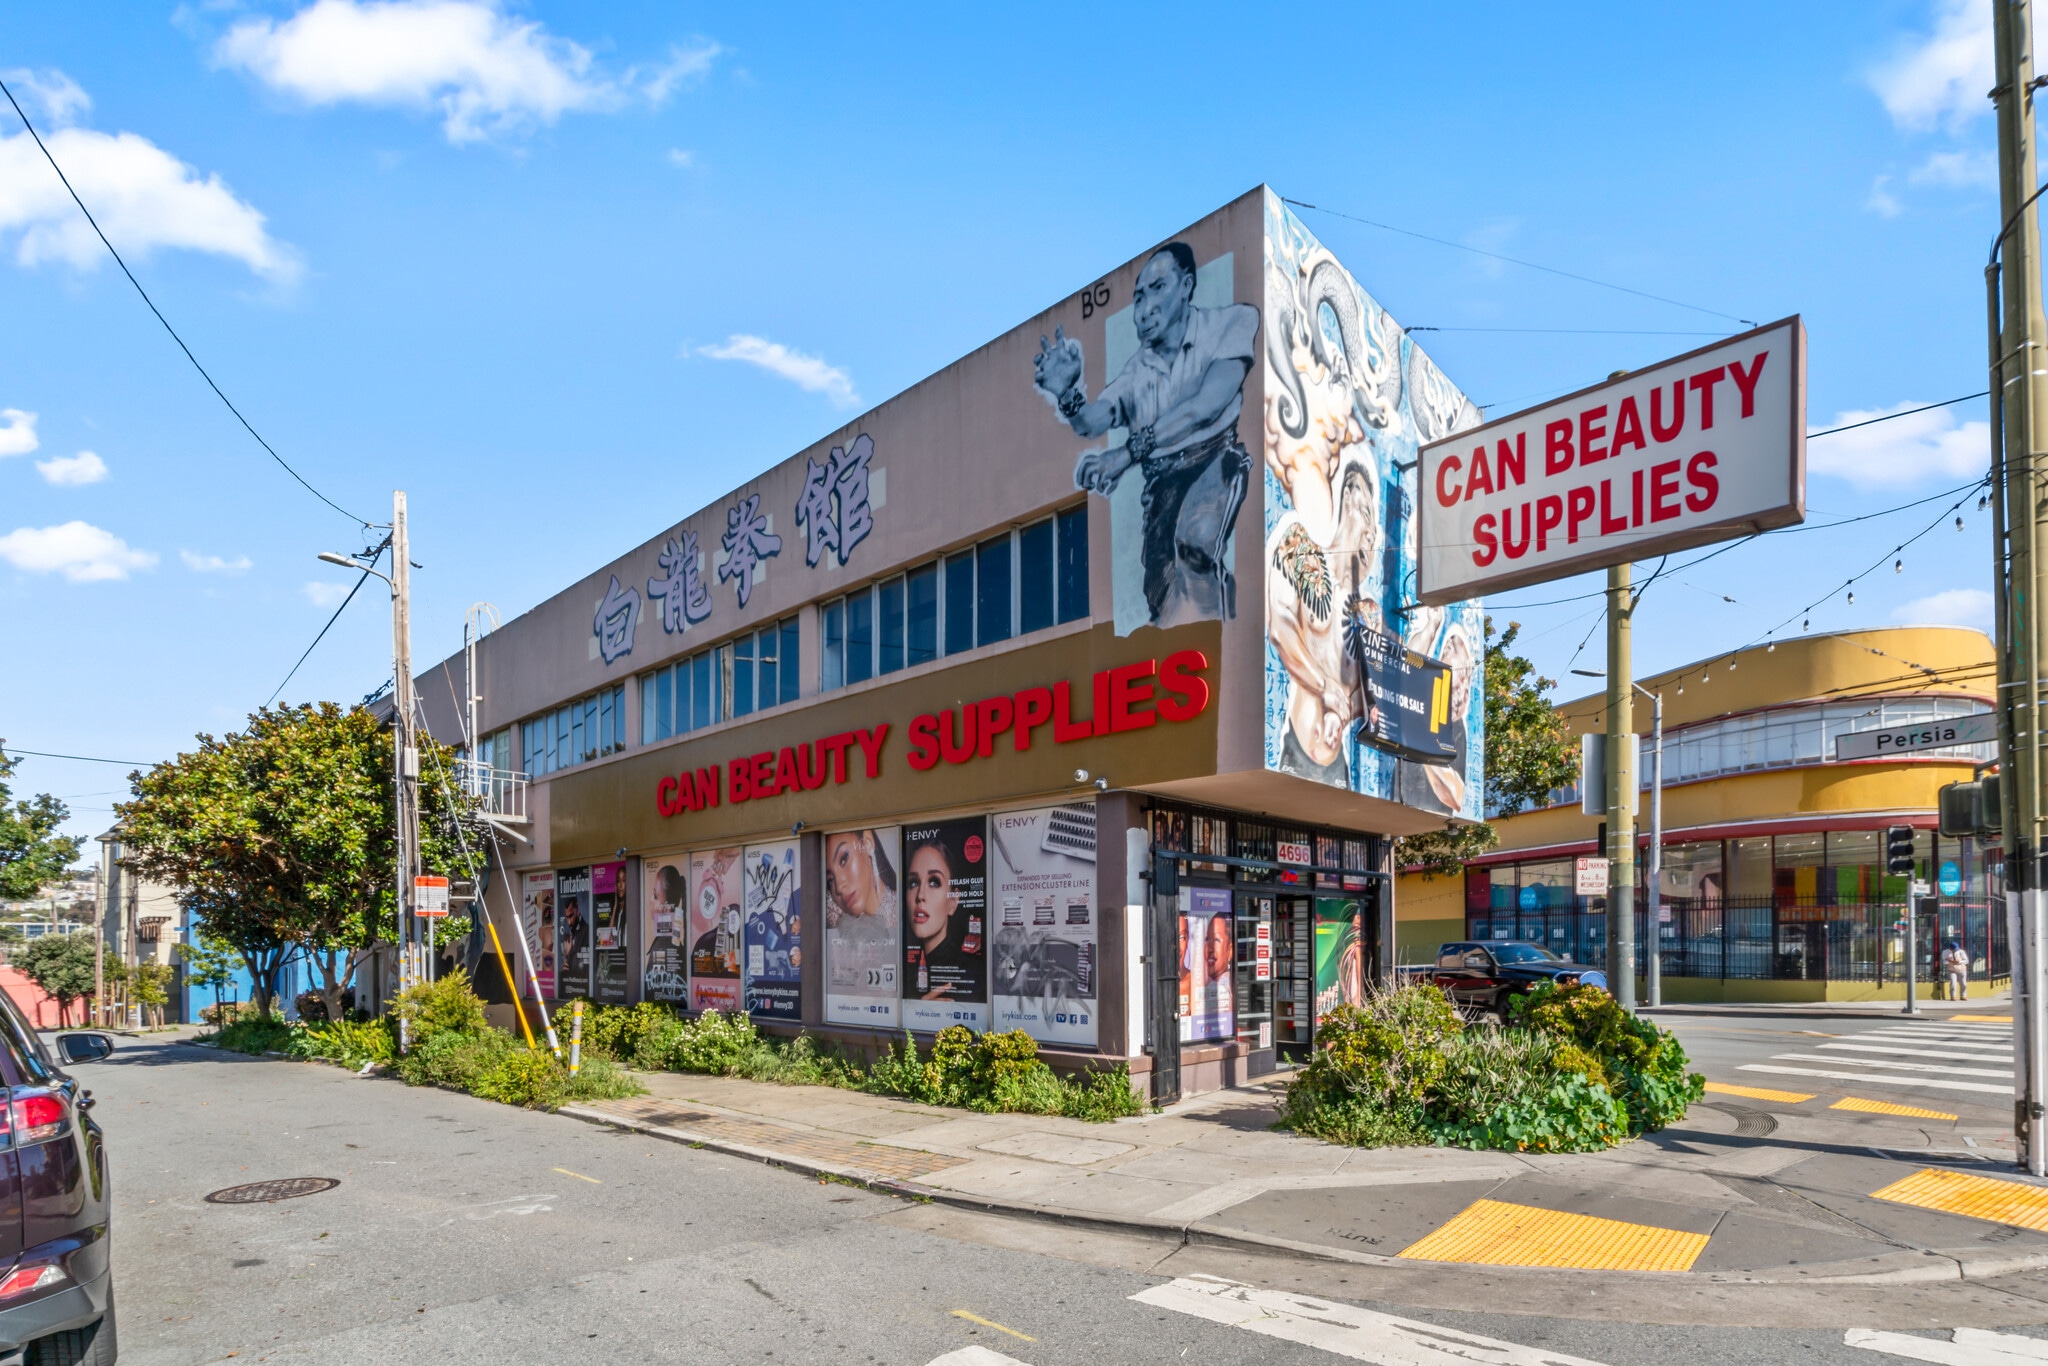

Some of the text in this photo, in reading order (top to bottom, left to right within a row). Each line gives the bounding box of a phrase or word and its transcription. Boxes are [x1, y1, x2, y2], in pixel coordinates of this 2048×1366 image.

[1082, 282, 1110, 320] BG
[1436, 351, 1770, 508] CAN BEAUTY
[1471, 450, 1719, 568] SUPPLIES
[1360, 627, 1408, 661] KINETIC
[1364, 646, 1411, 675] OMMERCIAL
[1396, 692, 1409, 711] FOR
[1409, 698, 1425, 715] SALE
[657, 764, 719, 818] CAN
[728, 723, 890, 803] BEAUTY
[907, 650, 1209, 771] SUPPLIES
[1877, 726, 1956, 750] Persia
[1279, 844, 1310, 863] 4696
[559, 874, 590, 894] Tintation
[948, 878, 970, 886] EYELASH
[1001, 880, 1090, 892] EXTENSION CLUSTER LINE
[1002, 1010, 1038, 1021] ivykiss.com
